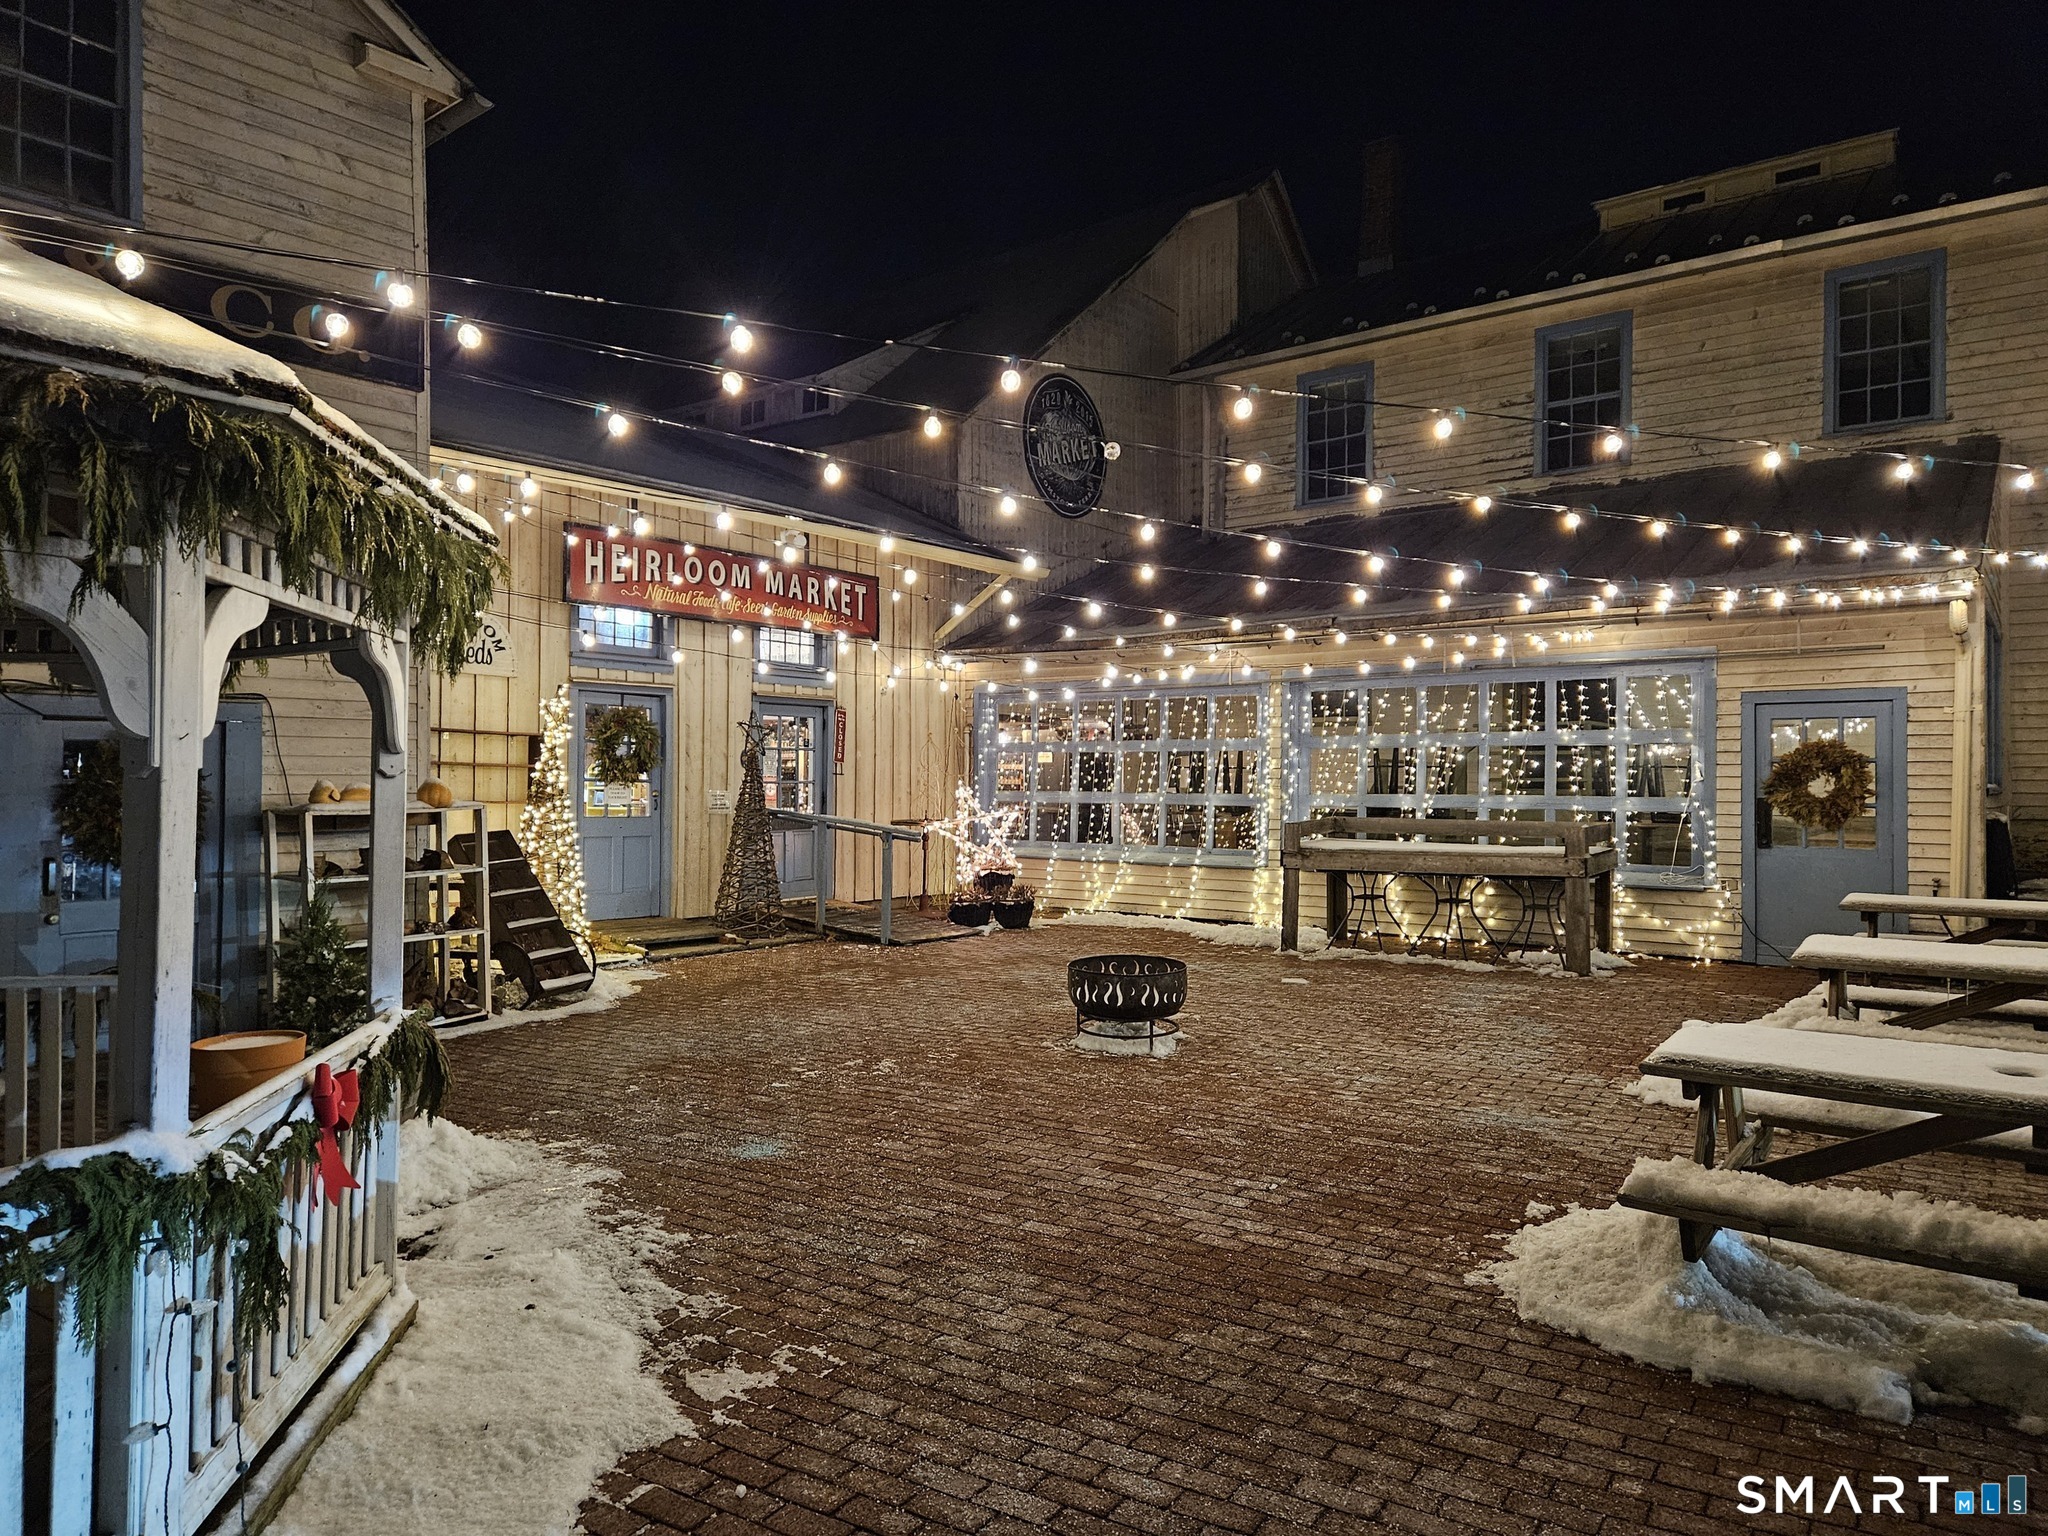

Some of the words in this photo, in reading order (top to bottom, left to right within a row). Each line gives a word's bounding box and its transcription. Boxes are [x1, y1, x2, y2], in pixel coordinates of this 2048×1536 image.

[1037, 437, 1098, 467] MARKET
[585, 538, 751, 590] HEIRLOOM
[643, 583, 692, 606] Natural
[692, 591, 719, 608] Foods
[771, 601, 802, 620] Garden
[801, 607, 838, 626] Supplies
[765, 571, 868, 621] MARKET
[465, 640, 493, 665] eds
[836, 722, 844, 759] CLOSED
